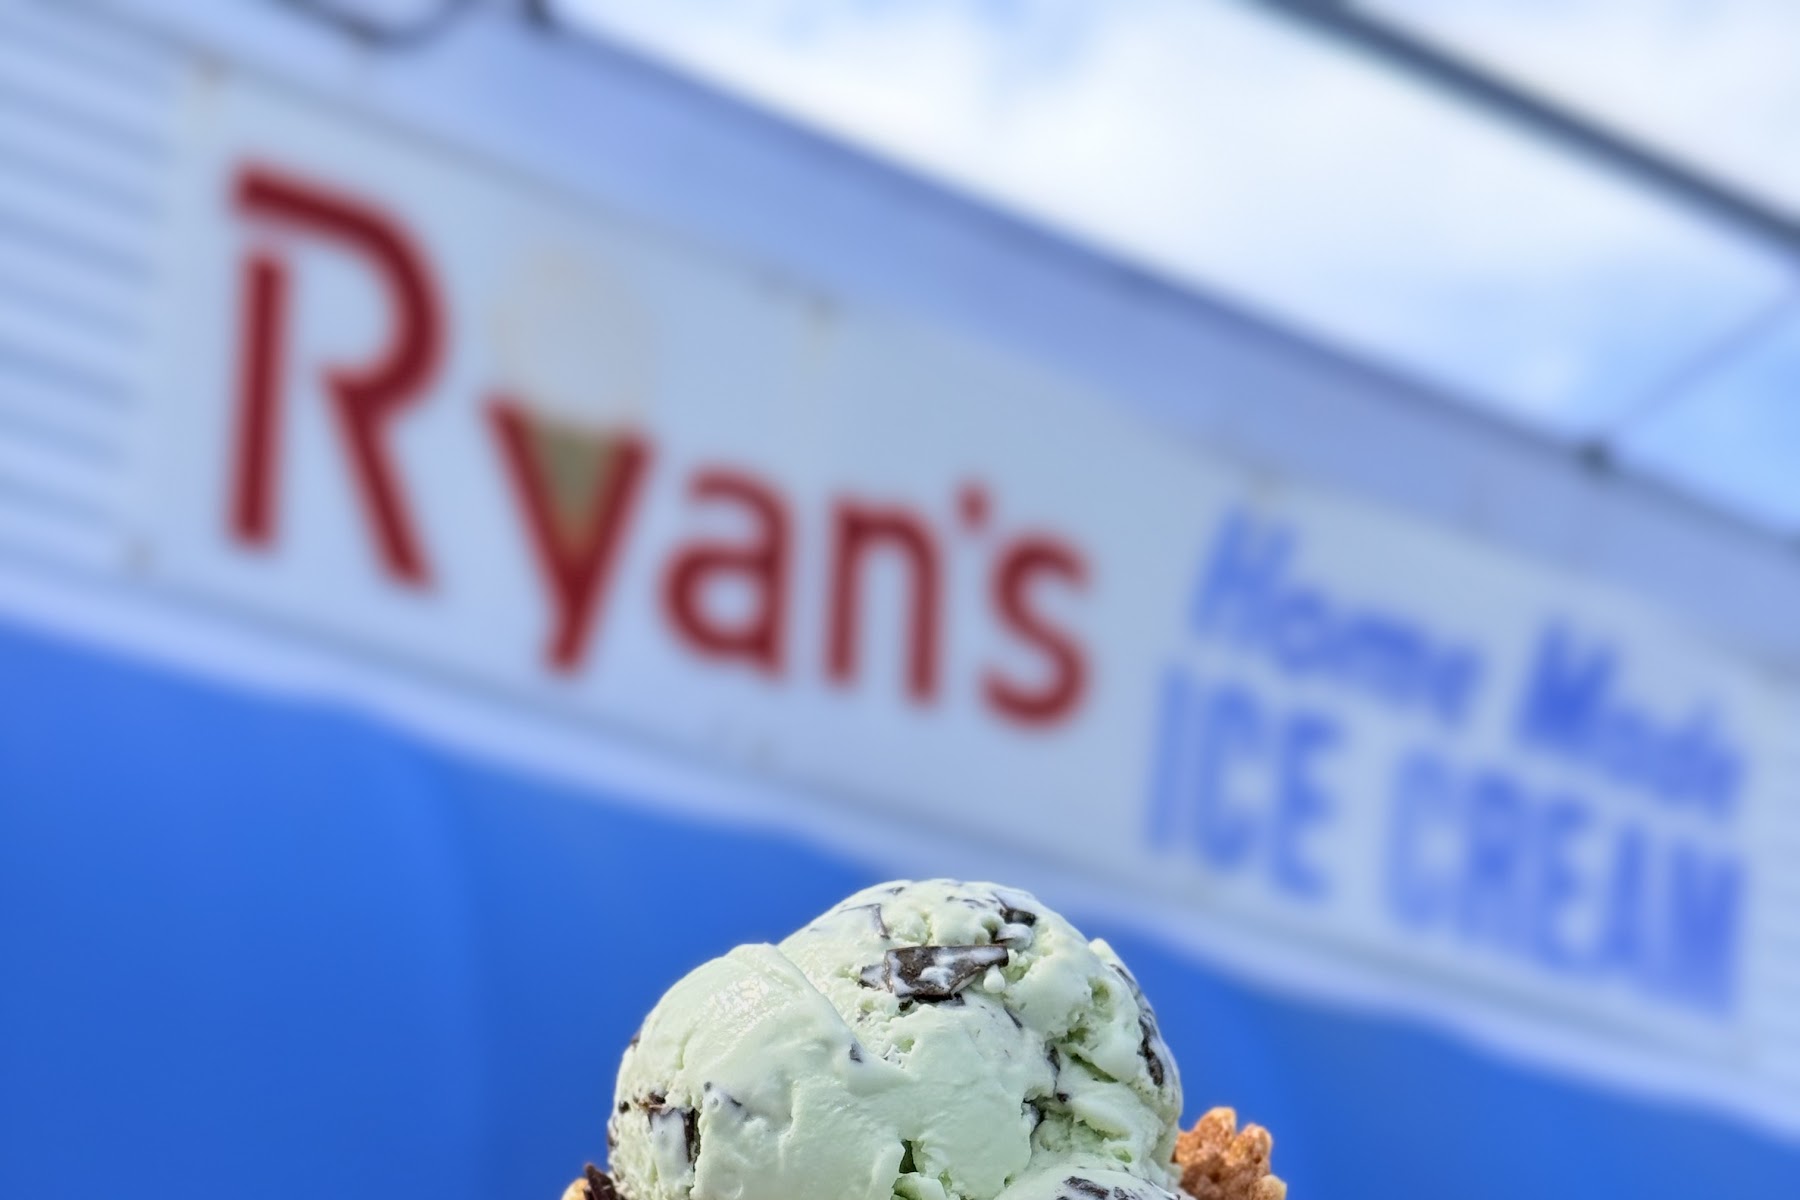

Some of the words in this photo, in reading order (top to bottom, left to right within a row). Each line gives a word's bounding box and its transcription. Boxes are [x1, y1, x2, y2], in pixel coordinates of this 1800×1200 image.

[226, 156, 1098, 733] Ryan's
[1145, 658, 1342, 902] ICE
[1386, 746, 1747, 1018] CREAM
[1190, 506, 1485, 730] Home
[1516, 616, 1746, 820] Made
